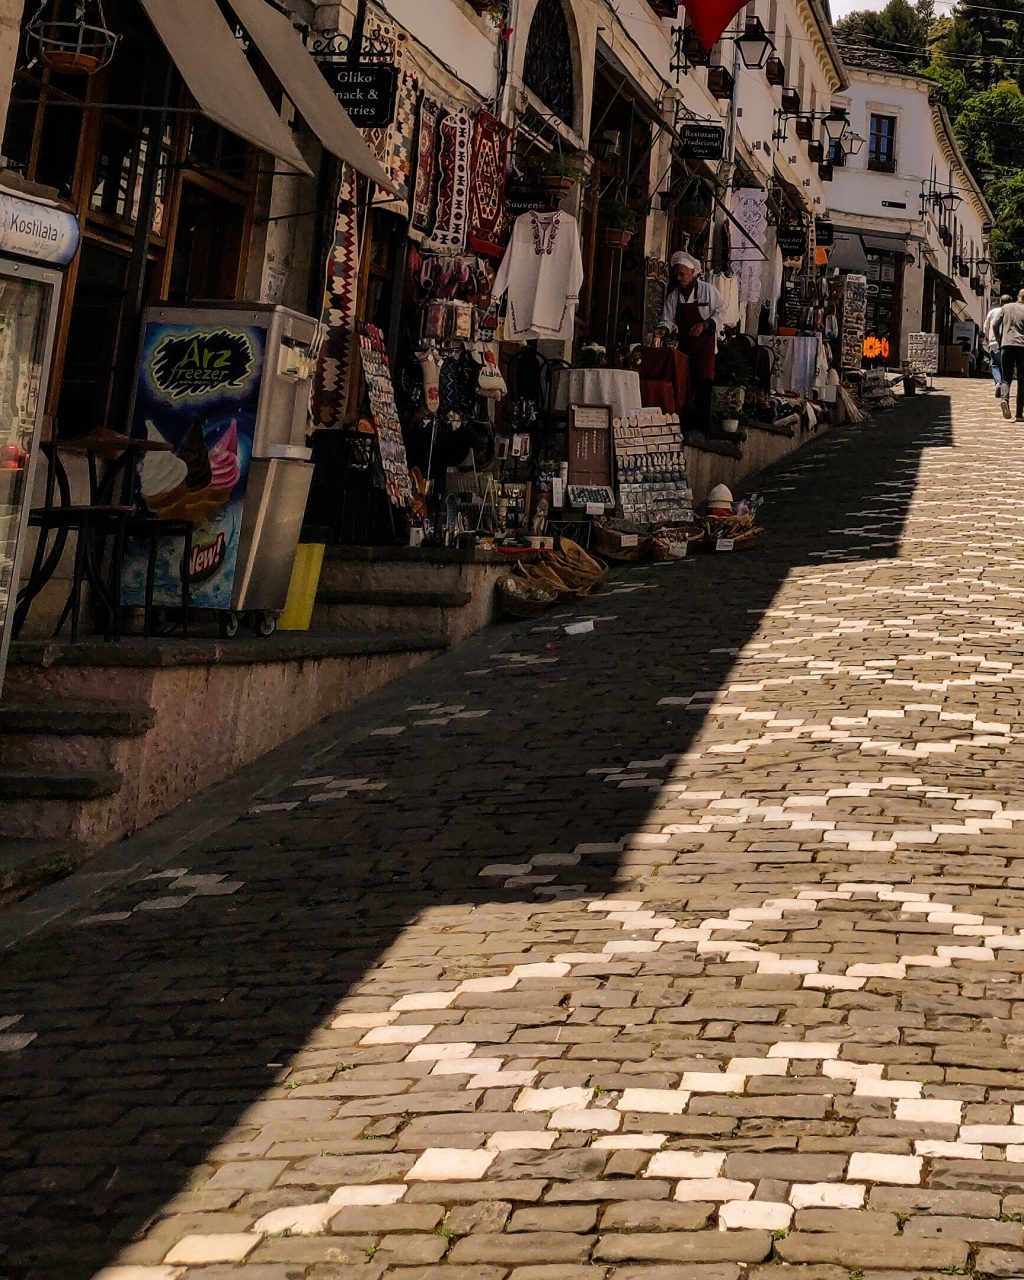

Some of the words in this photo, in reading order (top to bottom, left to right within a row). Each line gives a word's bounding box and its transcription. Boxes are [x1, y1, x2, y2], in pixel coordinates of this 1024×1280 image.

[335, 88, 365, 100] nack
[367, 88, 379, 100] &
[179, 339, 232, 369] Arz
[168, 367, 229, 384] freezer
